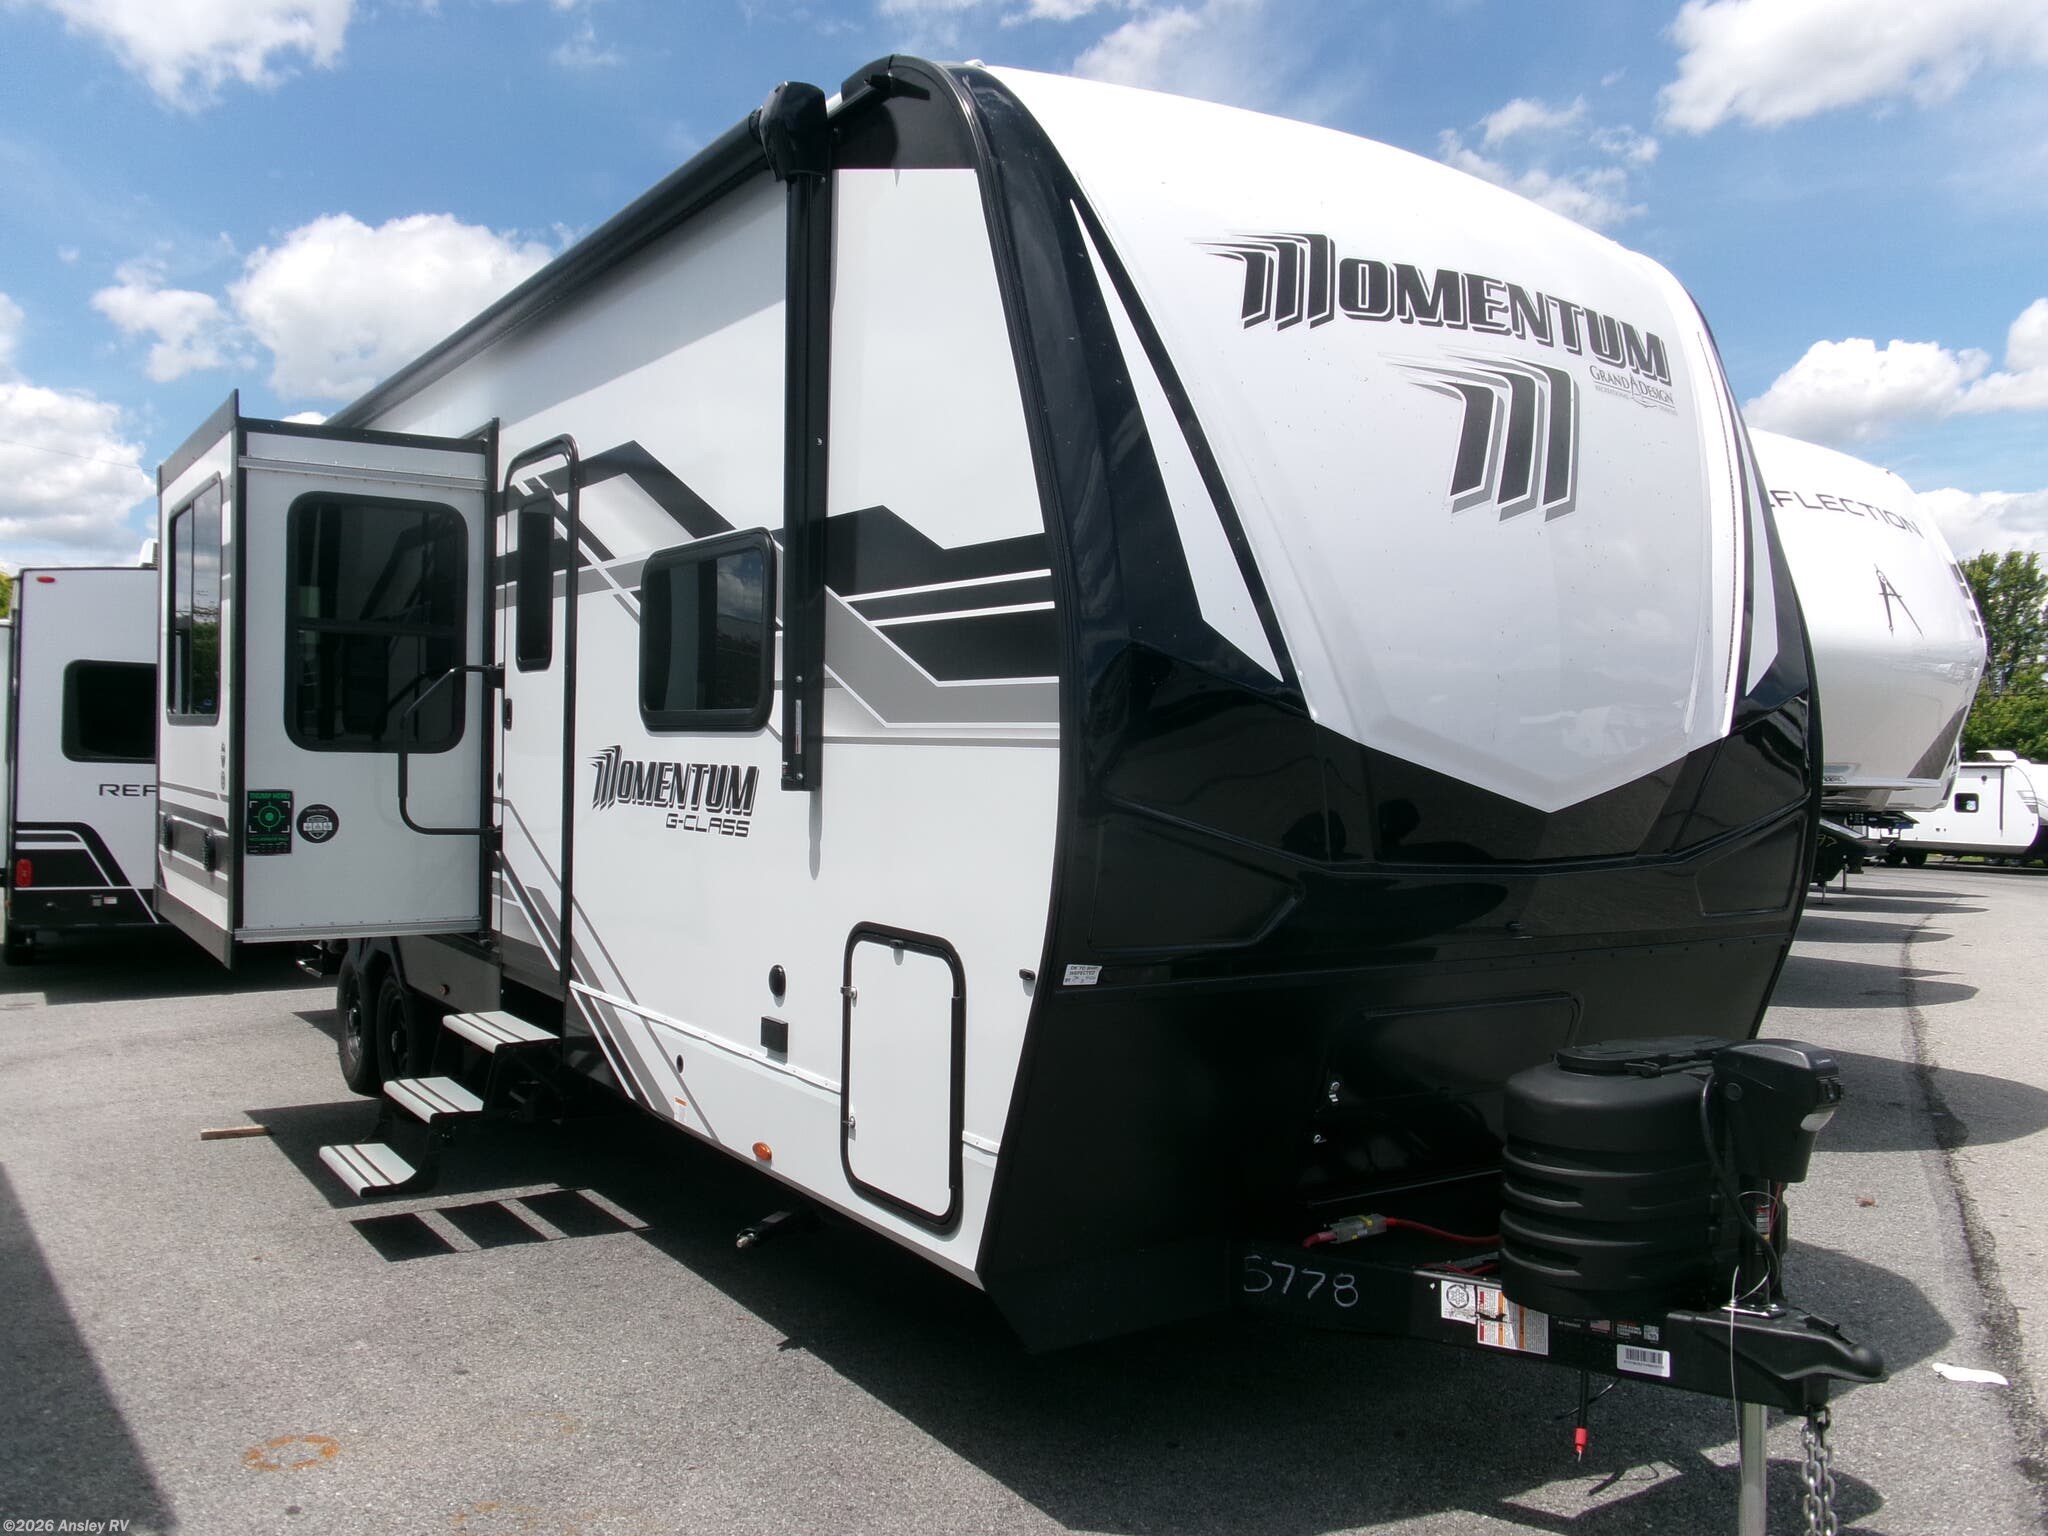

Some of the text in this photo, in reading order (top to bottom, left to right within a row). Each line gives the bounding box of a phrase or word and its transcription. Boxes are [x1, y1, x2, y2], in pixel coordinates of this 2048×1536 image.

[1192, 232, 1673, 386] MOMENTUM
[1589, 365, 1630, 389] GRAND
[1769, 490, 1925, 539] FLECTION
[586, 744, 760, 817] MOMENTUM
[665, 812, 751, 838] G-CLASS
[1243, 1255, 1360, 1307] 5778
